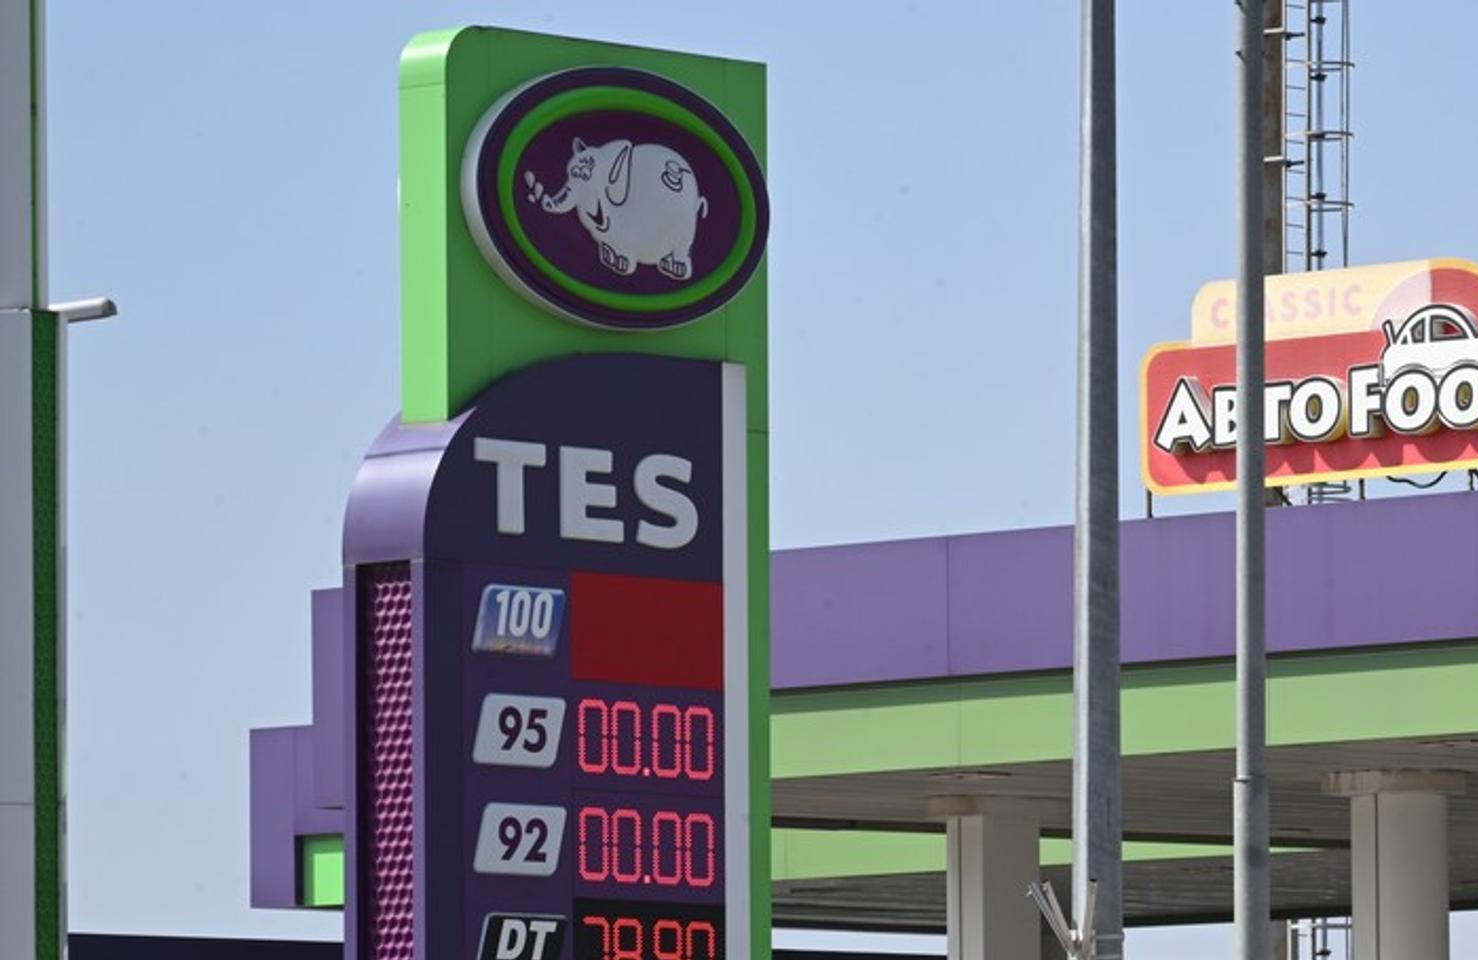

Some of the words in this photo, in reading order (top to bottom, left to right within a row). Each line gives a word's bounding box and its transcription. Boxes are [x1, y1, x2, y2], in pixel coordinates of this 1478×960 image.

[1210, 284, 1363, 330] CSSIC
[474, 436, 699, 549] TES
[496, 590, 554, 639] 100
[498, 706, 548, 754] 95
[578, 699, 715, 781] 00.00
[498, 816, 549, 863] 92
[578, 807, 716, 888] 00.00
